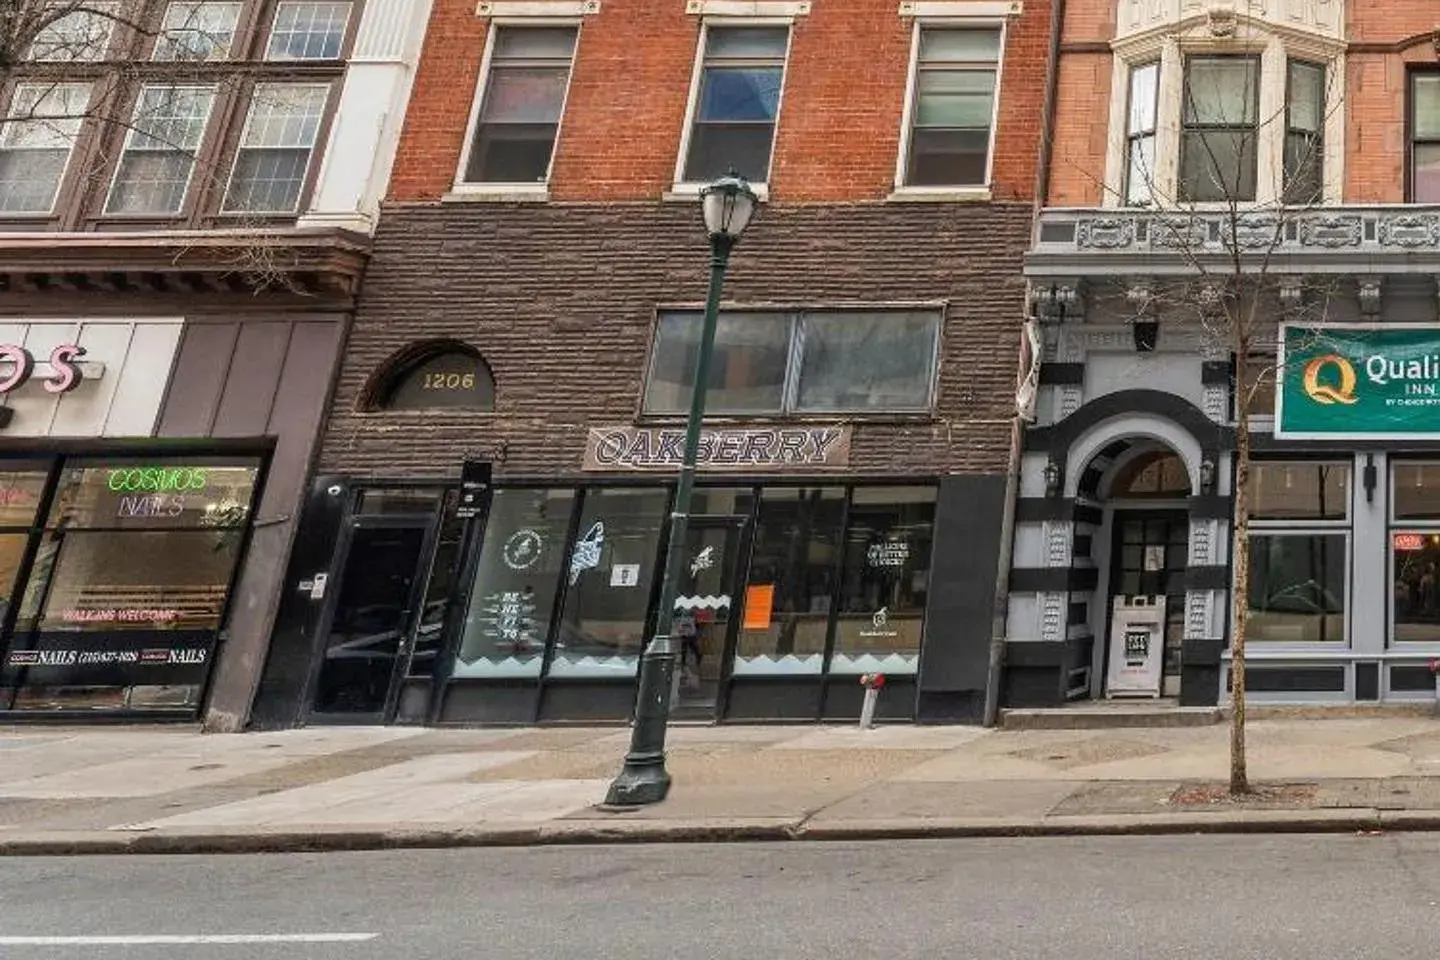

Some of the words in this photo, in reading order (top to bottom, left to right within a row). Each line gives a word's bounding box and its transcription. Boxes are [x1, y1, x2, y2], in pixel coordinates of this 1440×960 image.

[423, 374, 475, 389] 1206
[1405, 384, 1434, 394] INN
[38, 651, 77, 665] NAILS
[167, 650, 206, 664] NAILS
